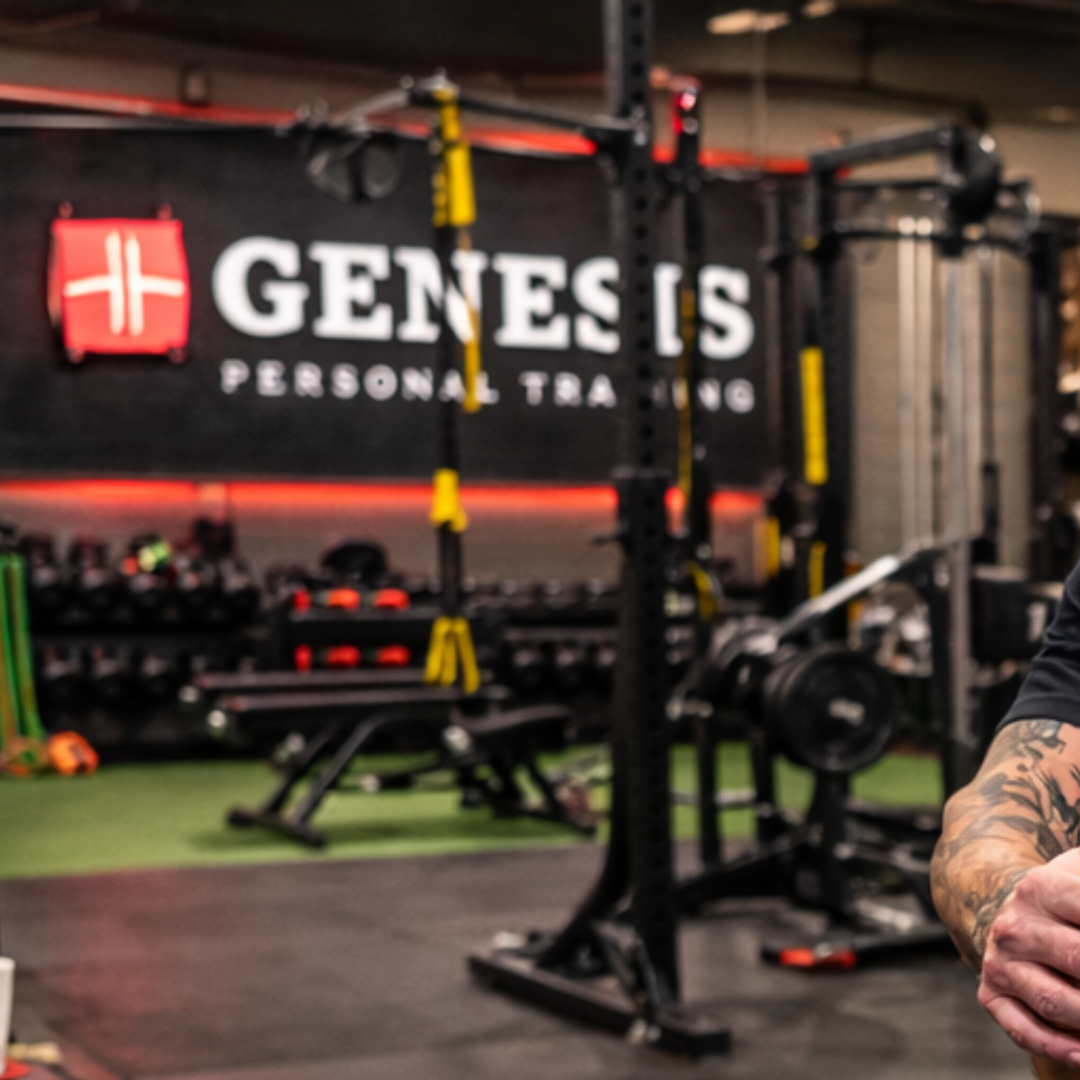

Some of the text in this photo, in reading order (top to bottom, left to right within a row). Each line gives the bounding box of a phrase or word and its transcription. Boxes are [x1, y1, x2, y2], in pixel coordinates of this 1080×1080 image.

[211, 236, 755, 359] GENESIS
[220, 358, 755, 413] PERSONAL TRAING
